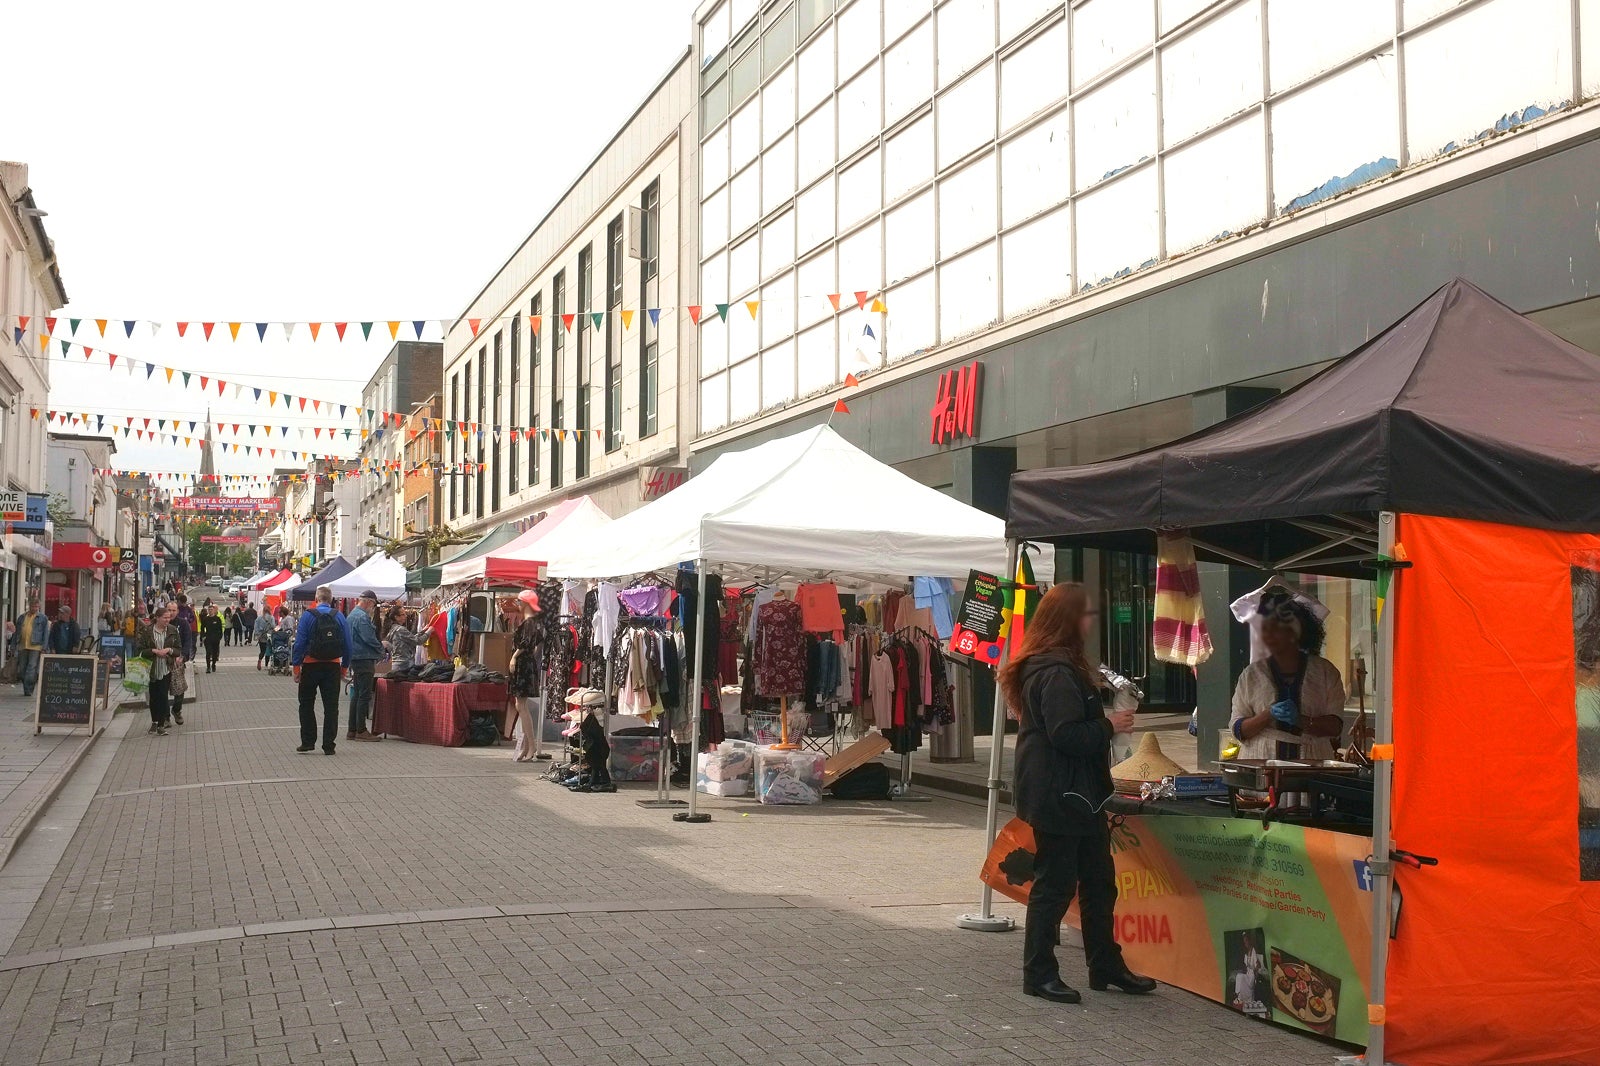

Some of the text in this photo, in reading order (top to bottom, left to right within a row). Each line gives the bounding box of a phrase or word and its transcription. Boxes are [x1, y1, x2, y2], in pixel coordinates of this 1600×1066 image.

[930, 361, 978, 445] H&M
[122, 550, 133, 558] JD
[976, 585, 992, 596] Vegan
[960, 638, 974, 650] £5
[1271, 859, 1305, 877] 310569
[1115, 869, 1175, 900] PIAN
[1274, 888, 1302, 902] Parties
[1306, 906, 1326, 922] Party
